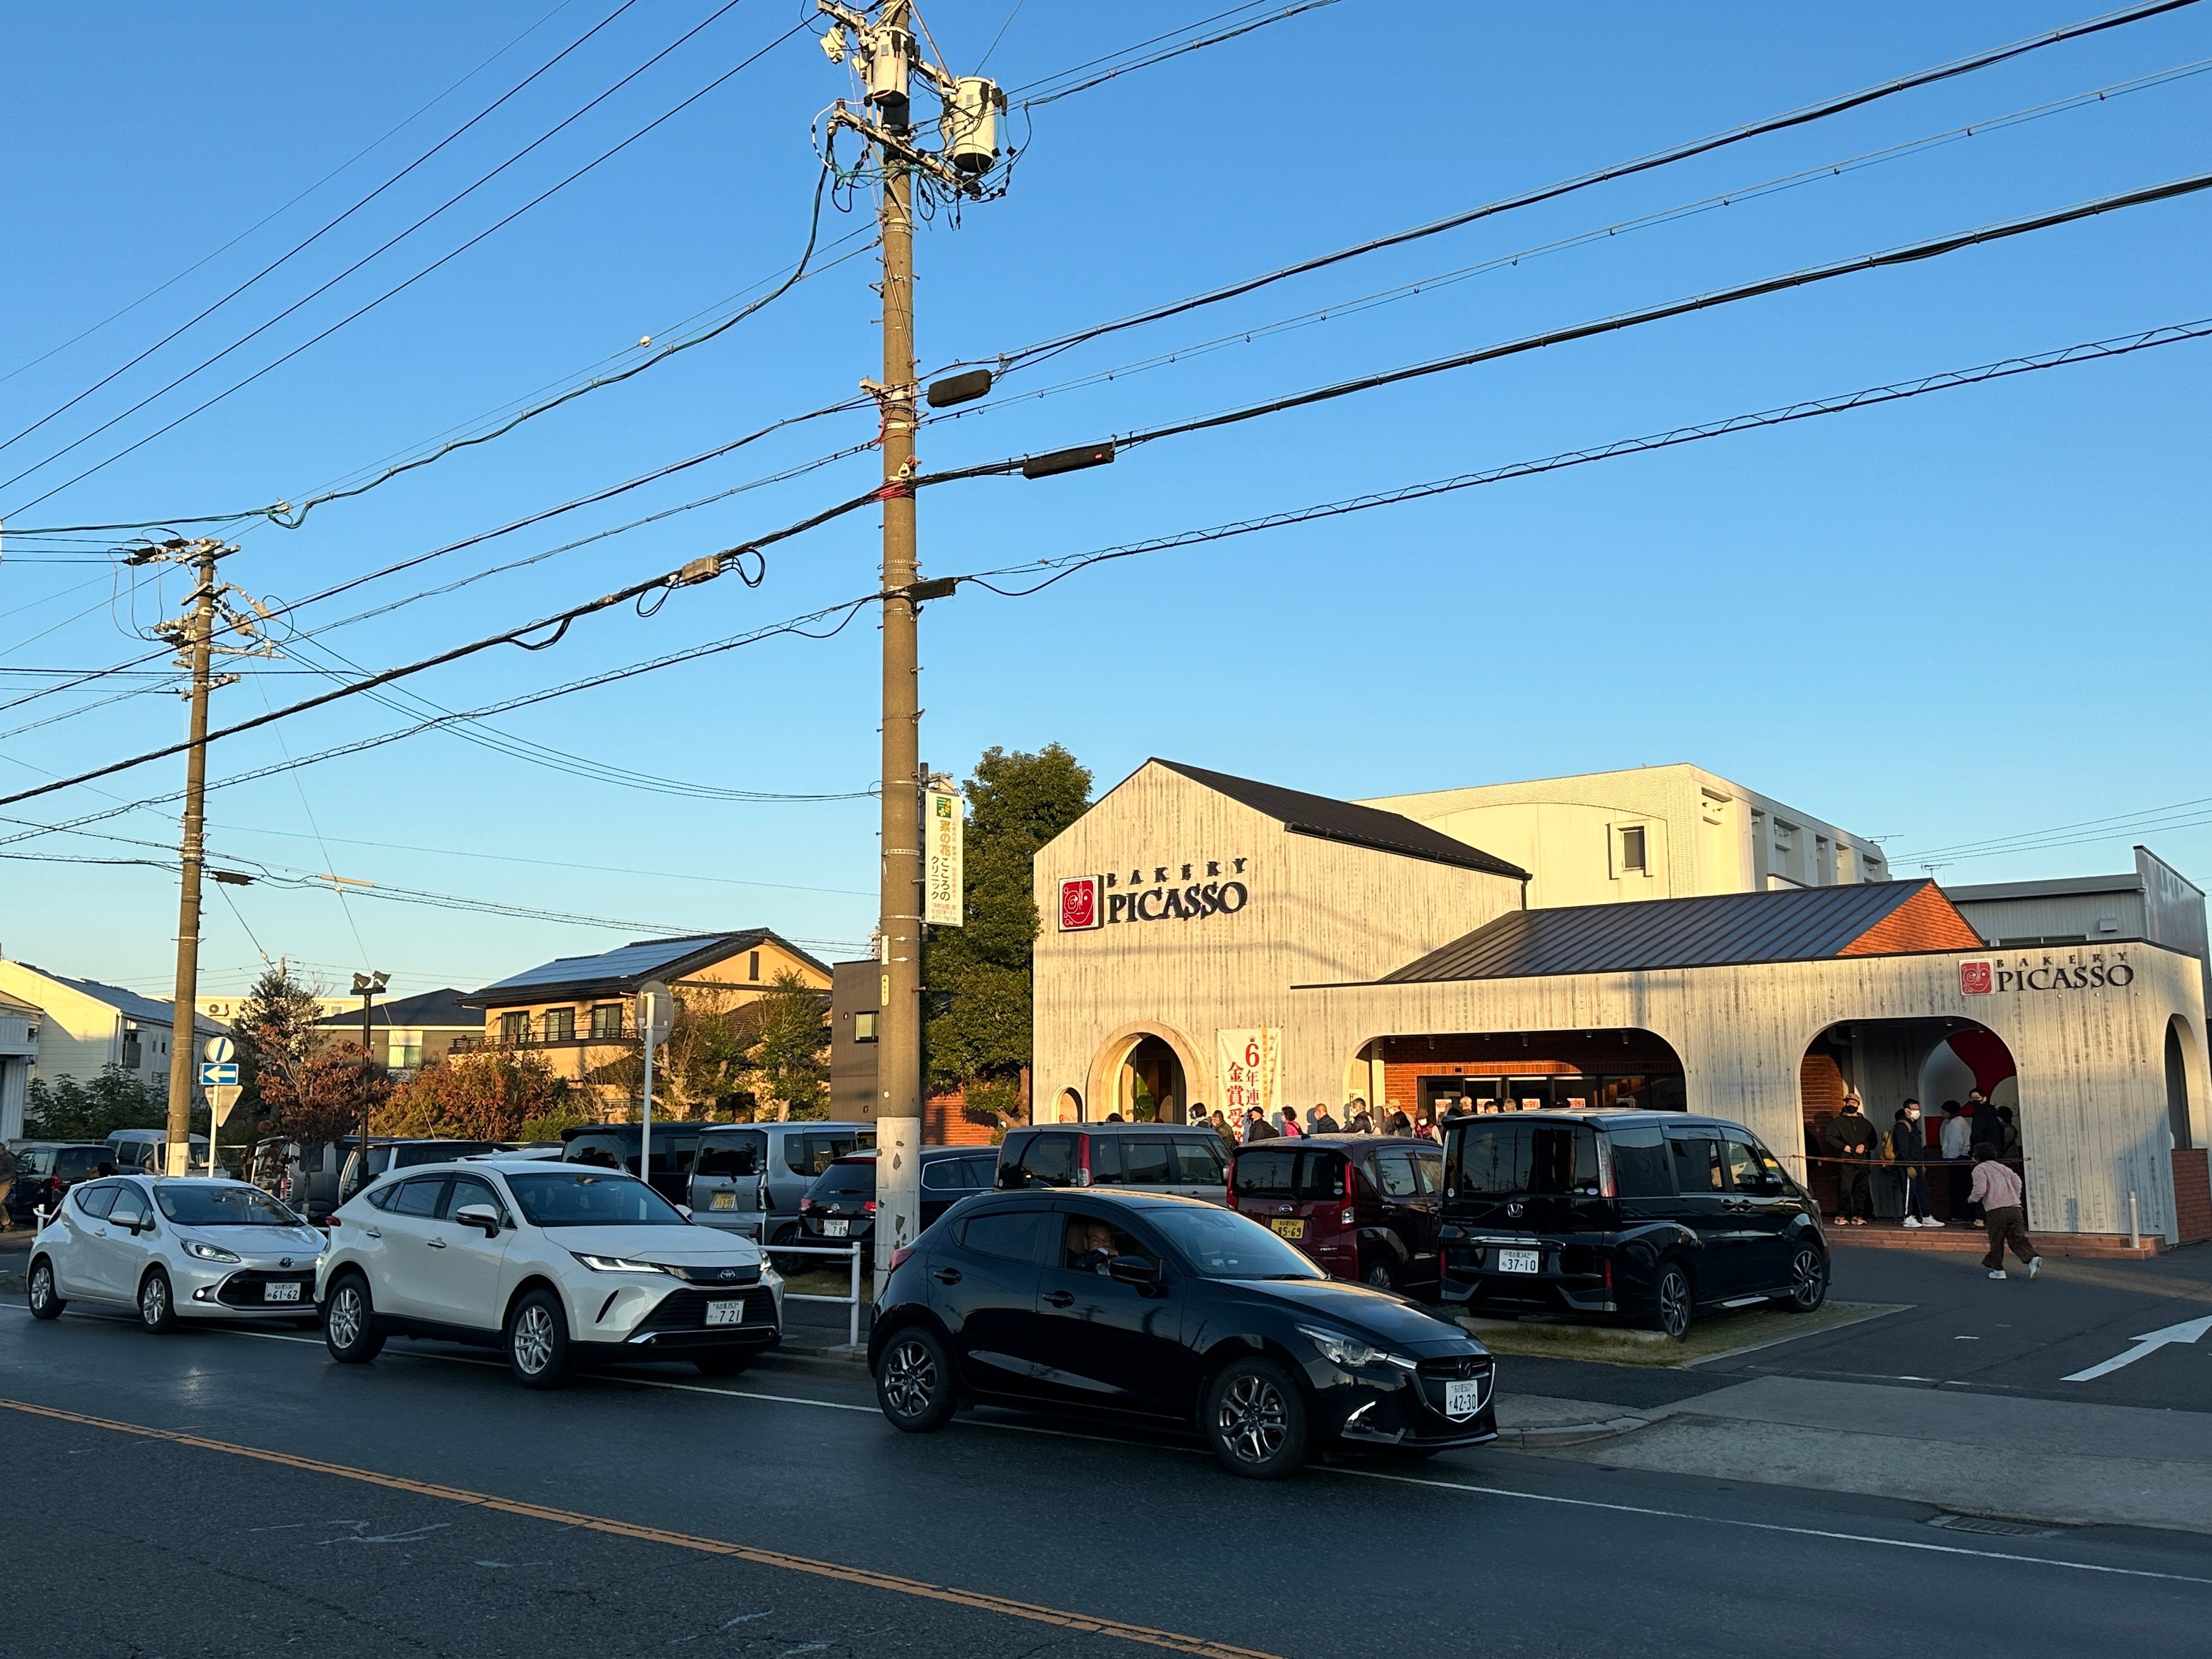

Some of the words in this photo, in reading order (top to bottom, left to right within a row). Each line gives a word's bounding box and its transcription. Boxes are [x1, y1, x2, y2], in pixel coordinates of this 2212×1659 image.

[931, 856, 939, 900] クリニック
[1107, 858, 1248, 888] BAKERY
[1107, 881, 1248, 923] PICASSO
[1996, 952, 2127, 968] BAKERY
[1996, 965, 2134, 992] PICASSO
[1246, 1043, 1260, 1109] 6年連
[1508, 1259, 1536, 1271] 37-10
[272, 1290, 298, 1299] 61-62
